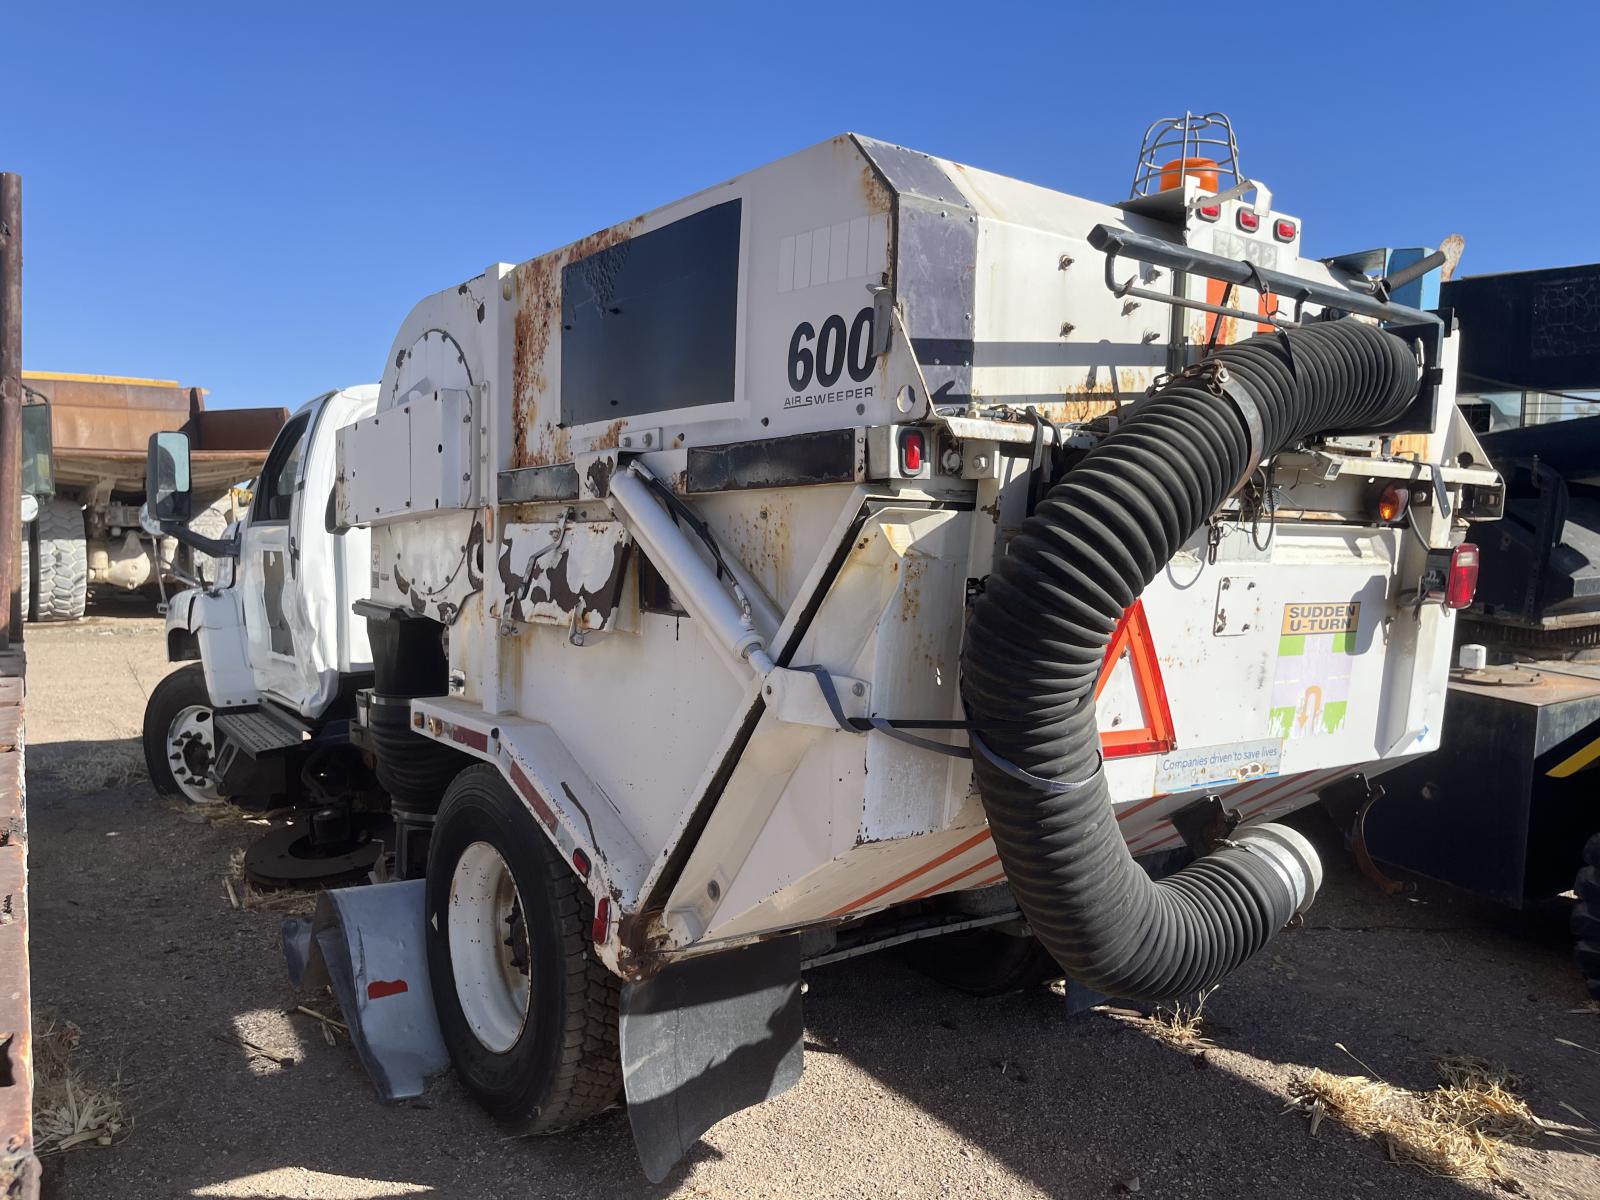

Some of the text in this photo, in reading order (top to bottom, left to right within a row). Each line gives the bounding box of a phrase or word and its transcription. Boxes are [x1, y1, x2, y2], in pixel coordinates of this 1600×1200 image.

[788, 307, 877, 392] 600
[784, 387, 873, 406] AIR SWEEPER
[1289, 605, 1356, 618] SUDDEN
[1290, 618, 1352, 631] U-TURN
[1163, 746, 1277, 771] Companies driven to save lives
